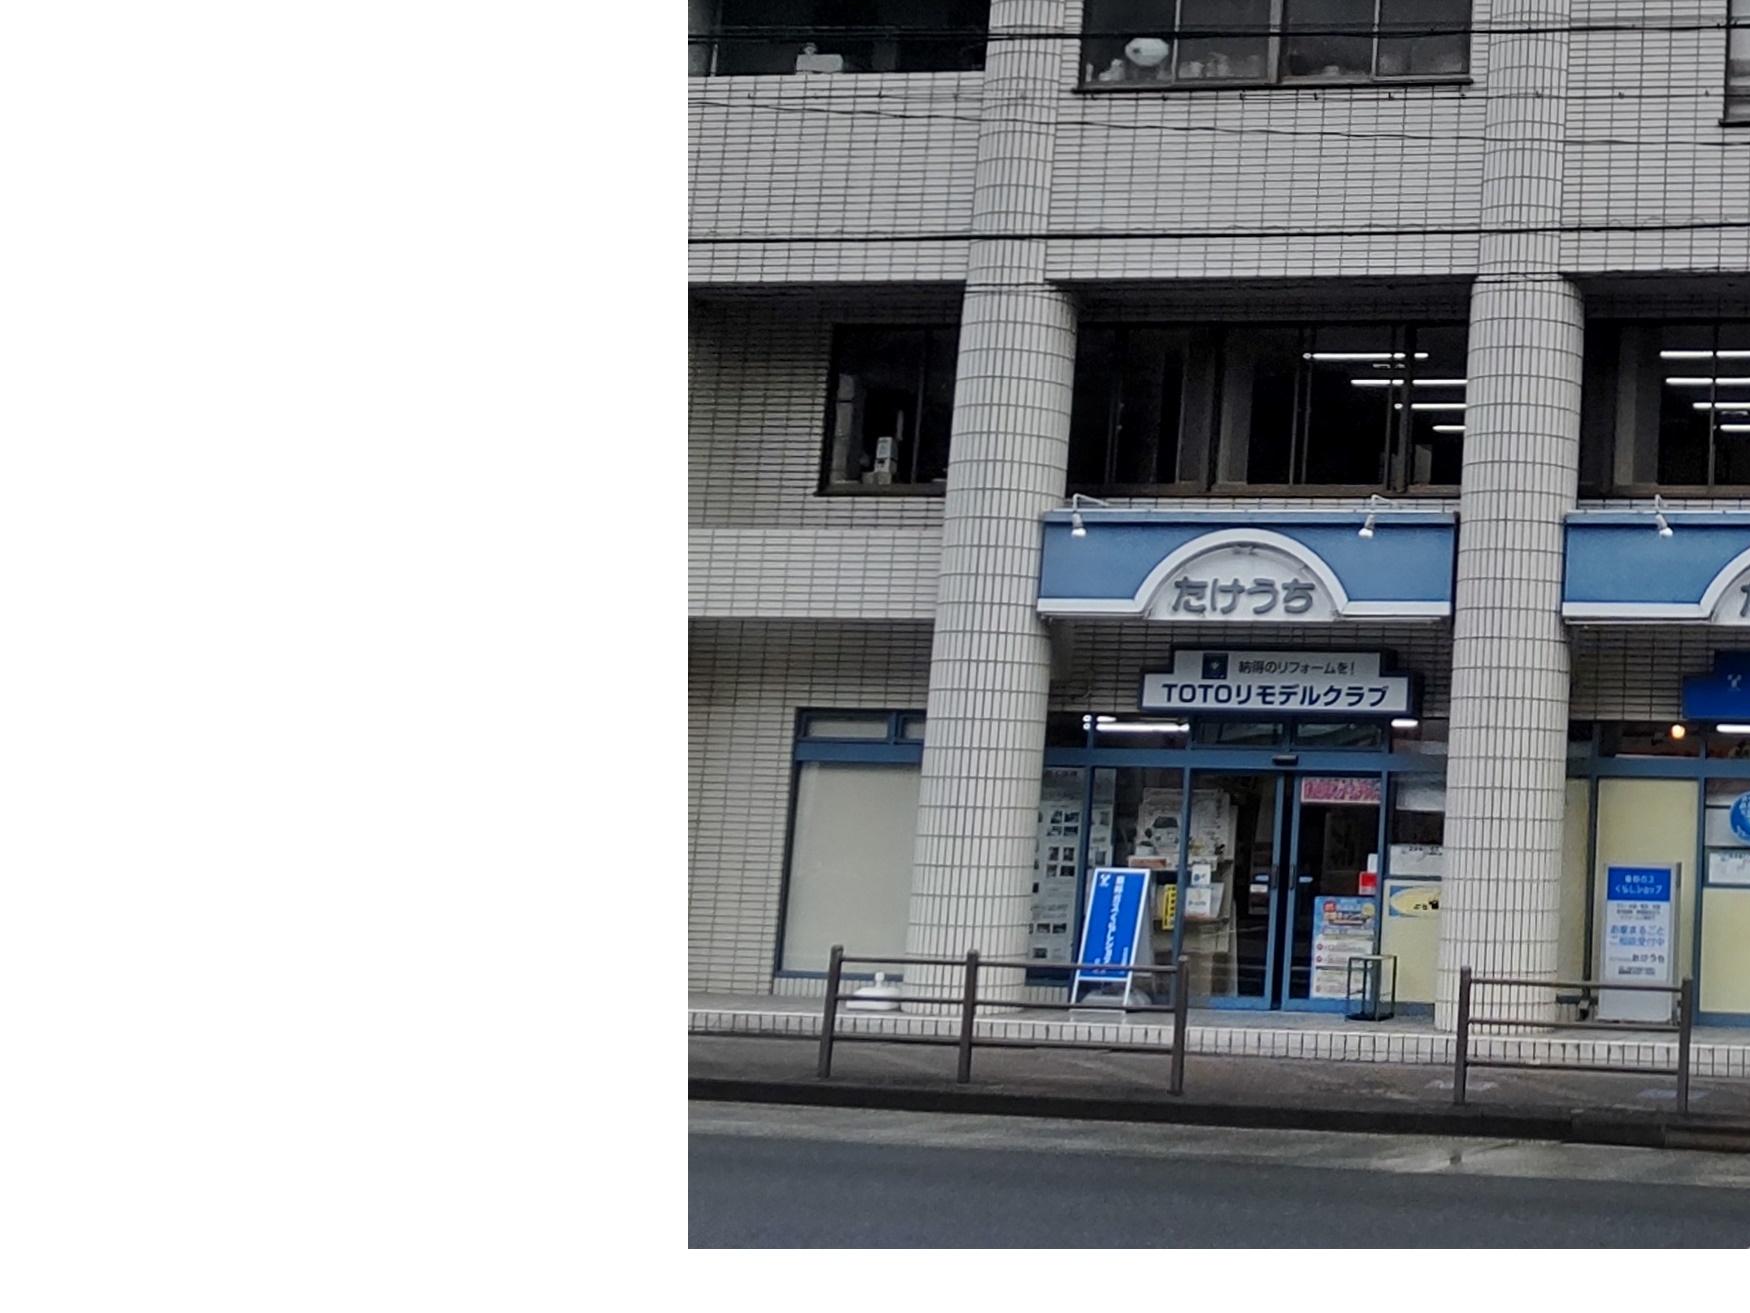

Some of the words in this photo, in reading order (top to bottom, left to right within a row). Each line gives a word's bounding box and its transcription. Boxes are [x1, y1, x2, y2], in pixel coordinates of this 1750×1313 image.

[1172, 577, 1316, 614] たけうち
[1162, 683, 1389, 708] TOTOリモデルクラブ
